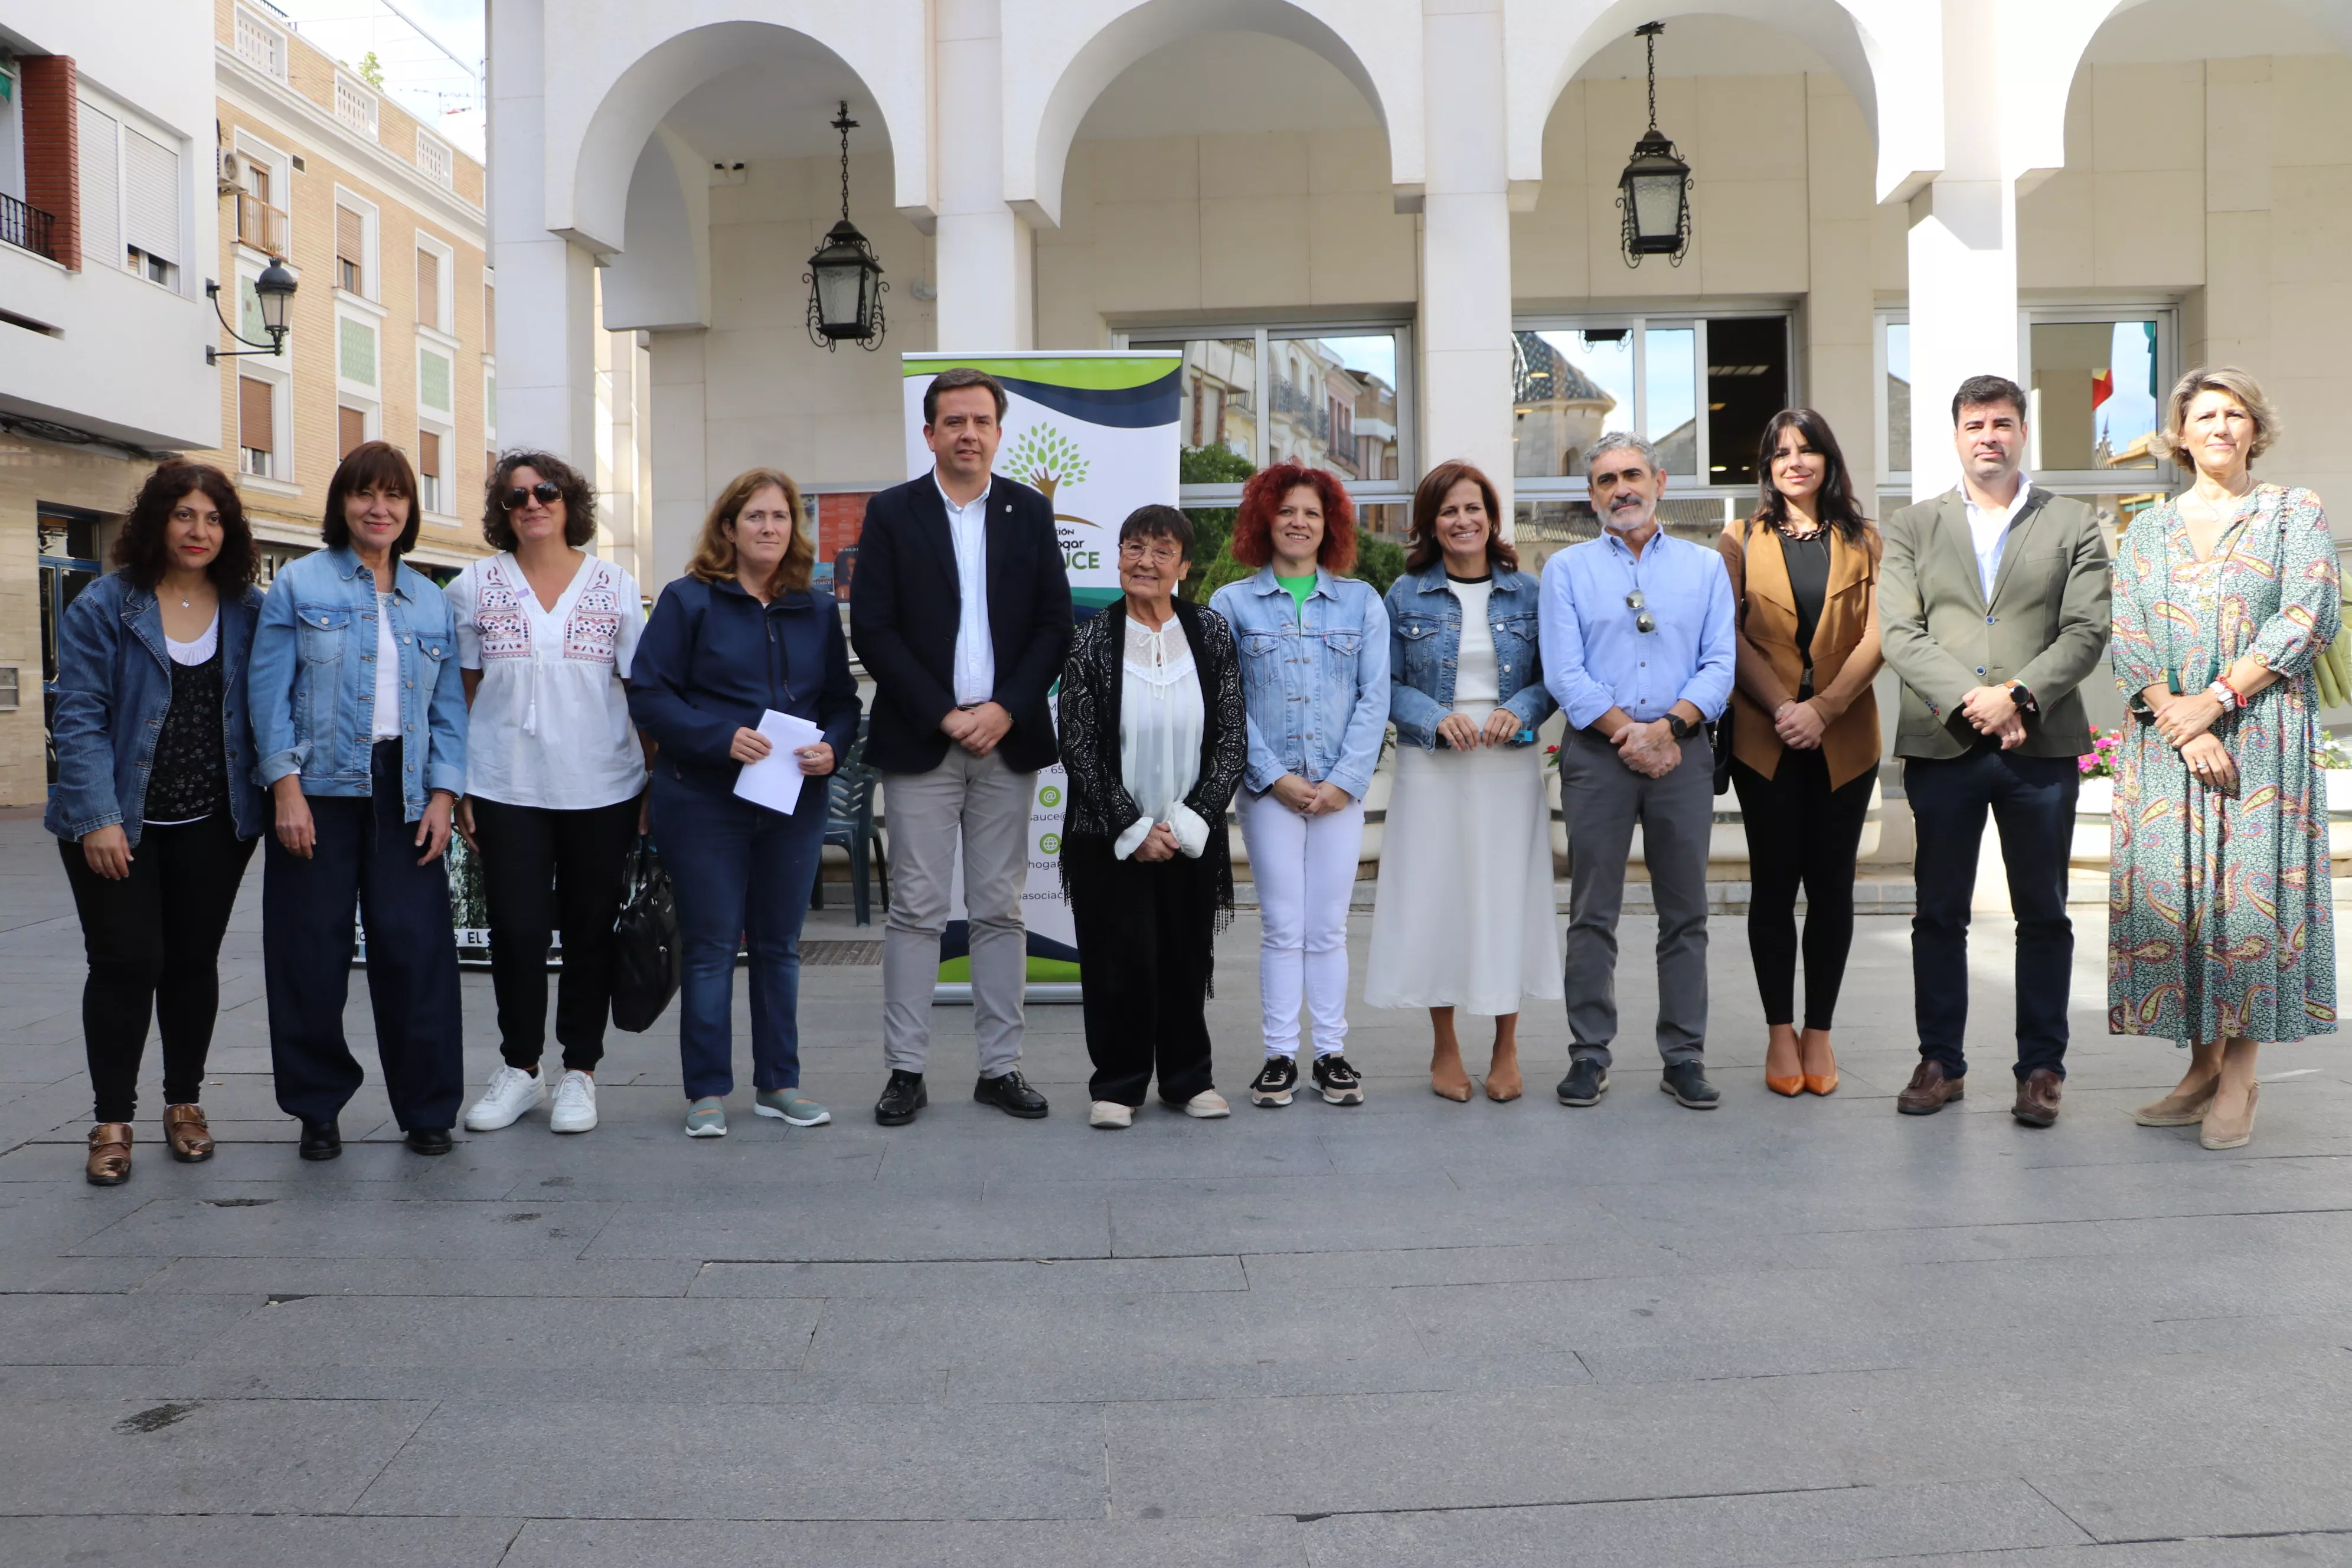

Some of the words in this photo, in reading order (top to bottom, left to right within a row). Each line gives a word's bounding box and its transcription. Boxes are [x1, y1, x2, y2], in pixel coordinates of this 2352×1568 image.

[1057, 527, 1074, 535] ión
[1020, 891, 1063, 900] asociac
[468, 932, 483, 944] EL
